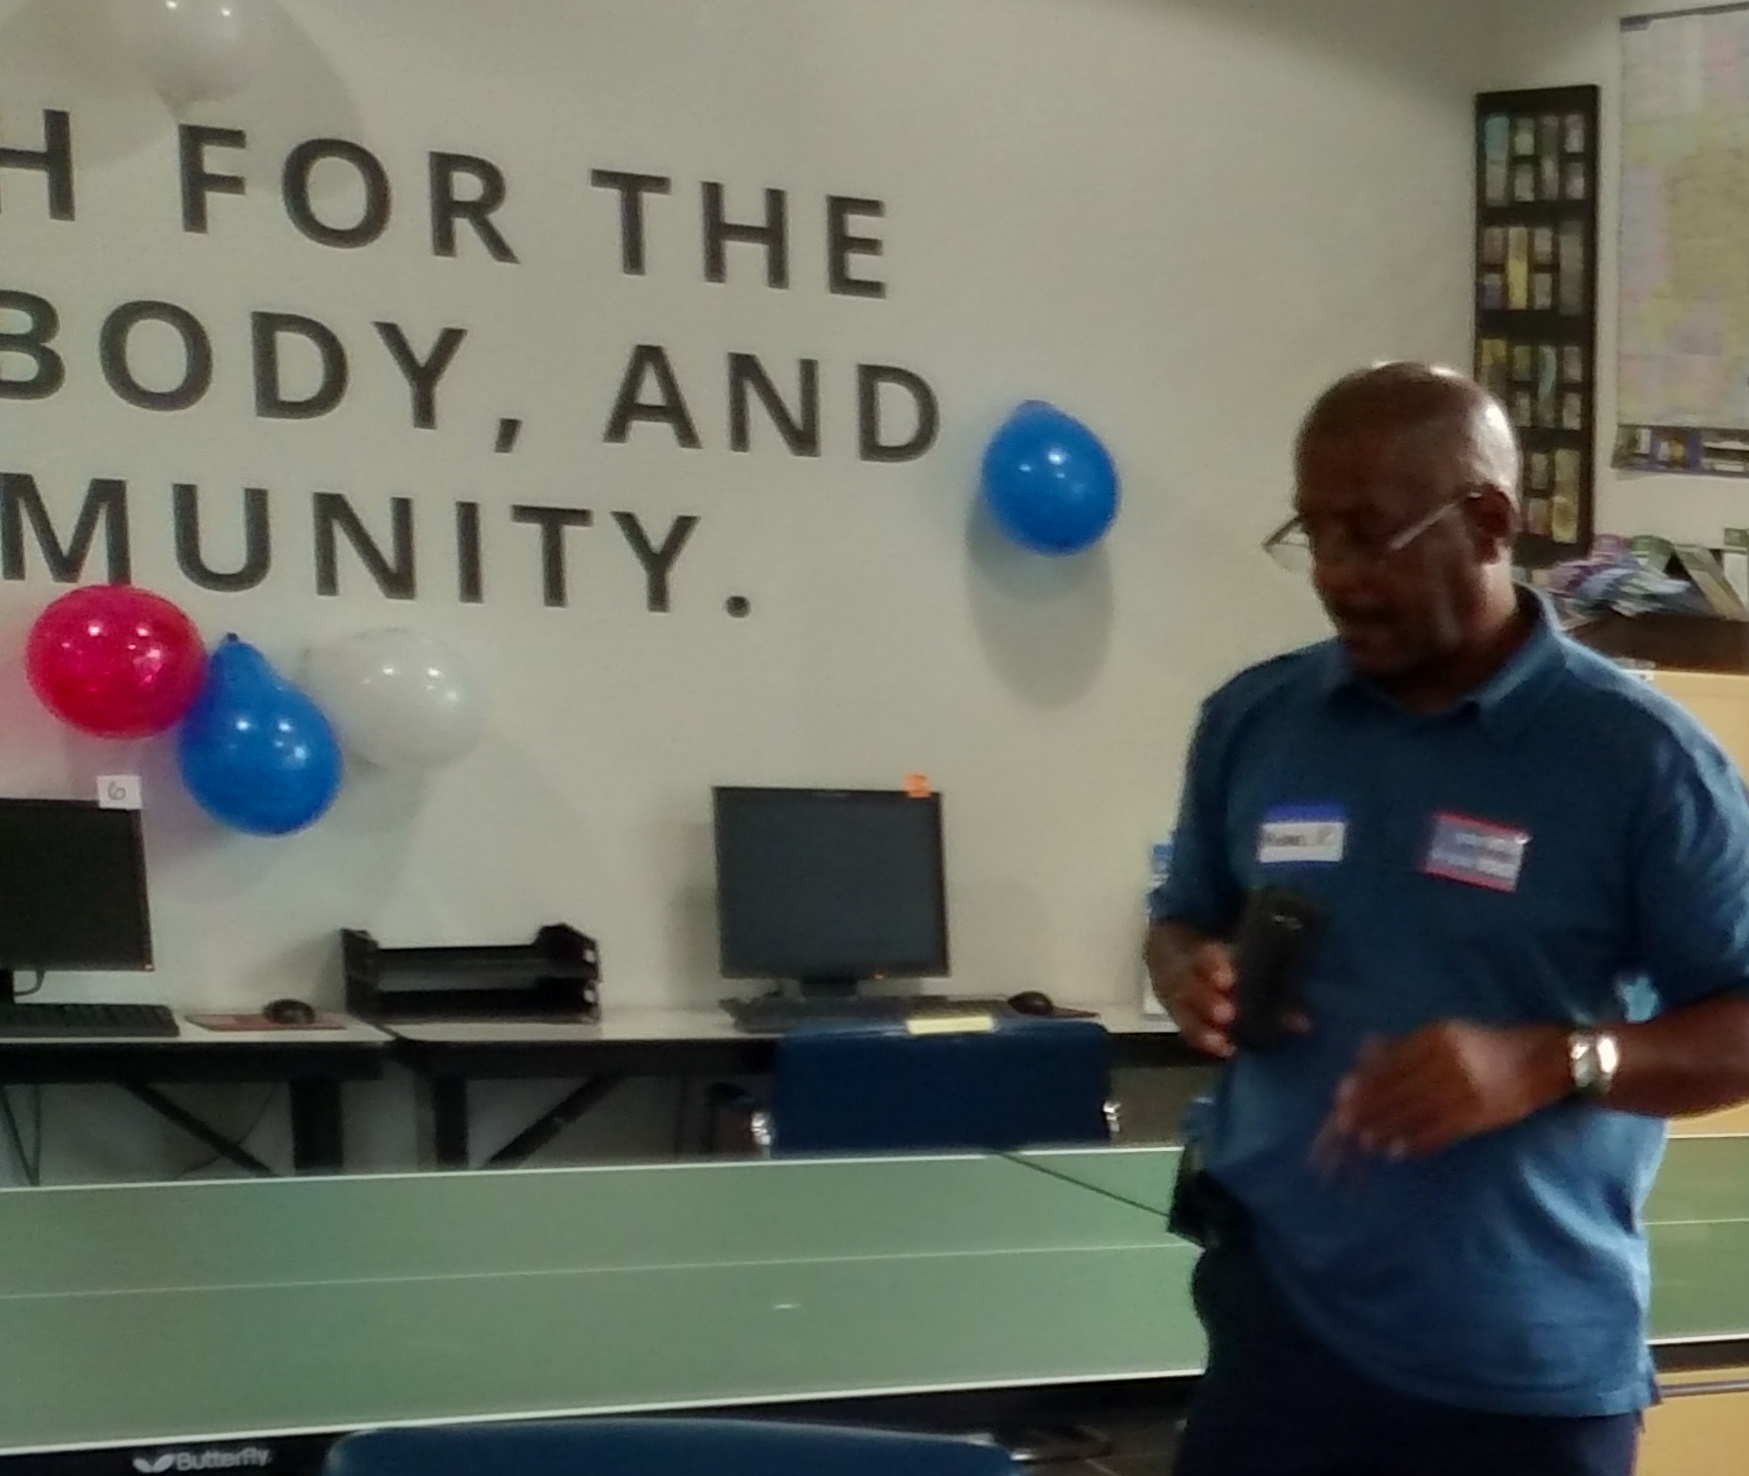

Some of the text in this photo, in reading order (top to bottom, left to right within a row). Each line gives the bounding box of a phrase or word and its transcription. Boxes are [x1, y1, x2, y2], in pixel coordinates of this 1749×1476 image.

[176, 122, 519, 265] FOR
[590, 167, 889, 299] THE
[0, 289, 941, 463] BODY, AND
[0, 471, 752, 618] MUNITY.
[107, 780, 127, 801] 6
[175, 1447, 270, 1471] Butterfly
